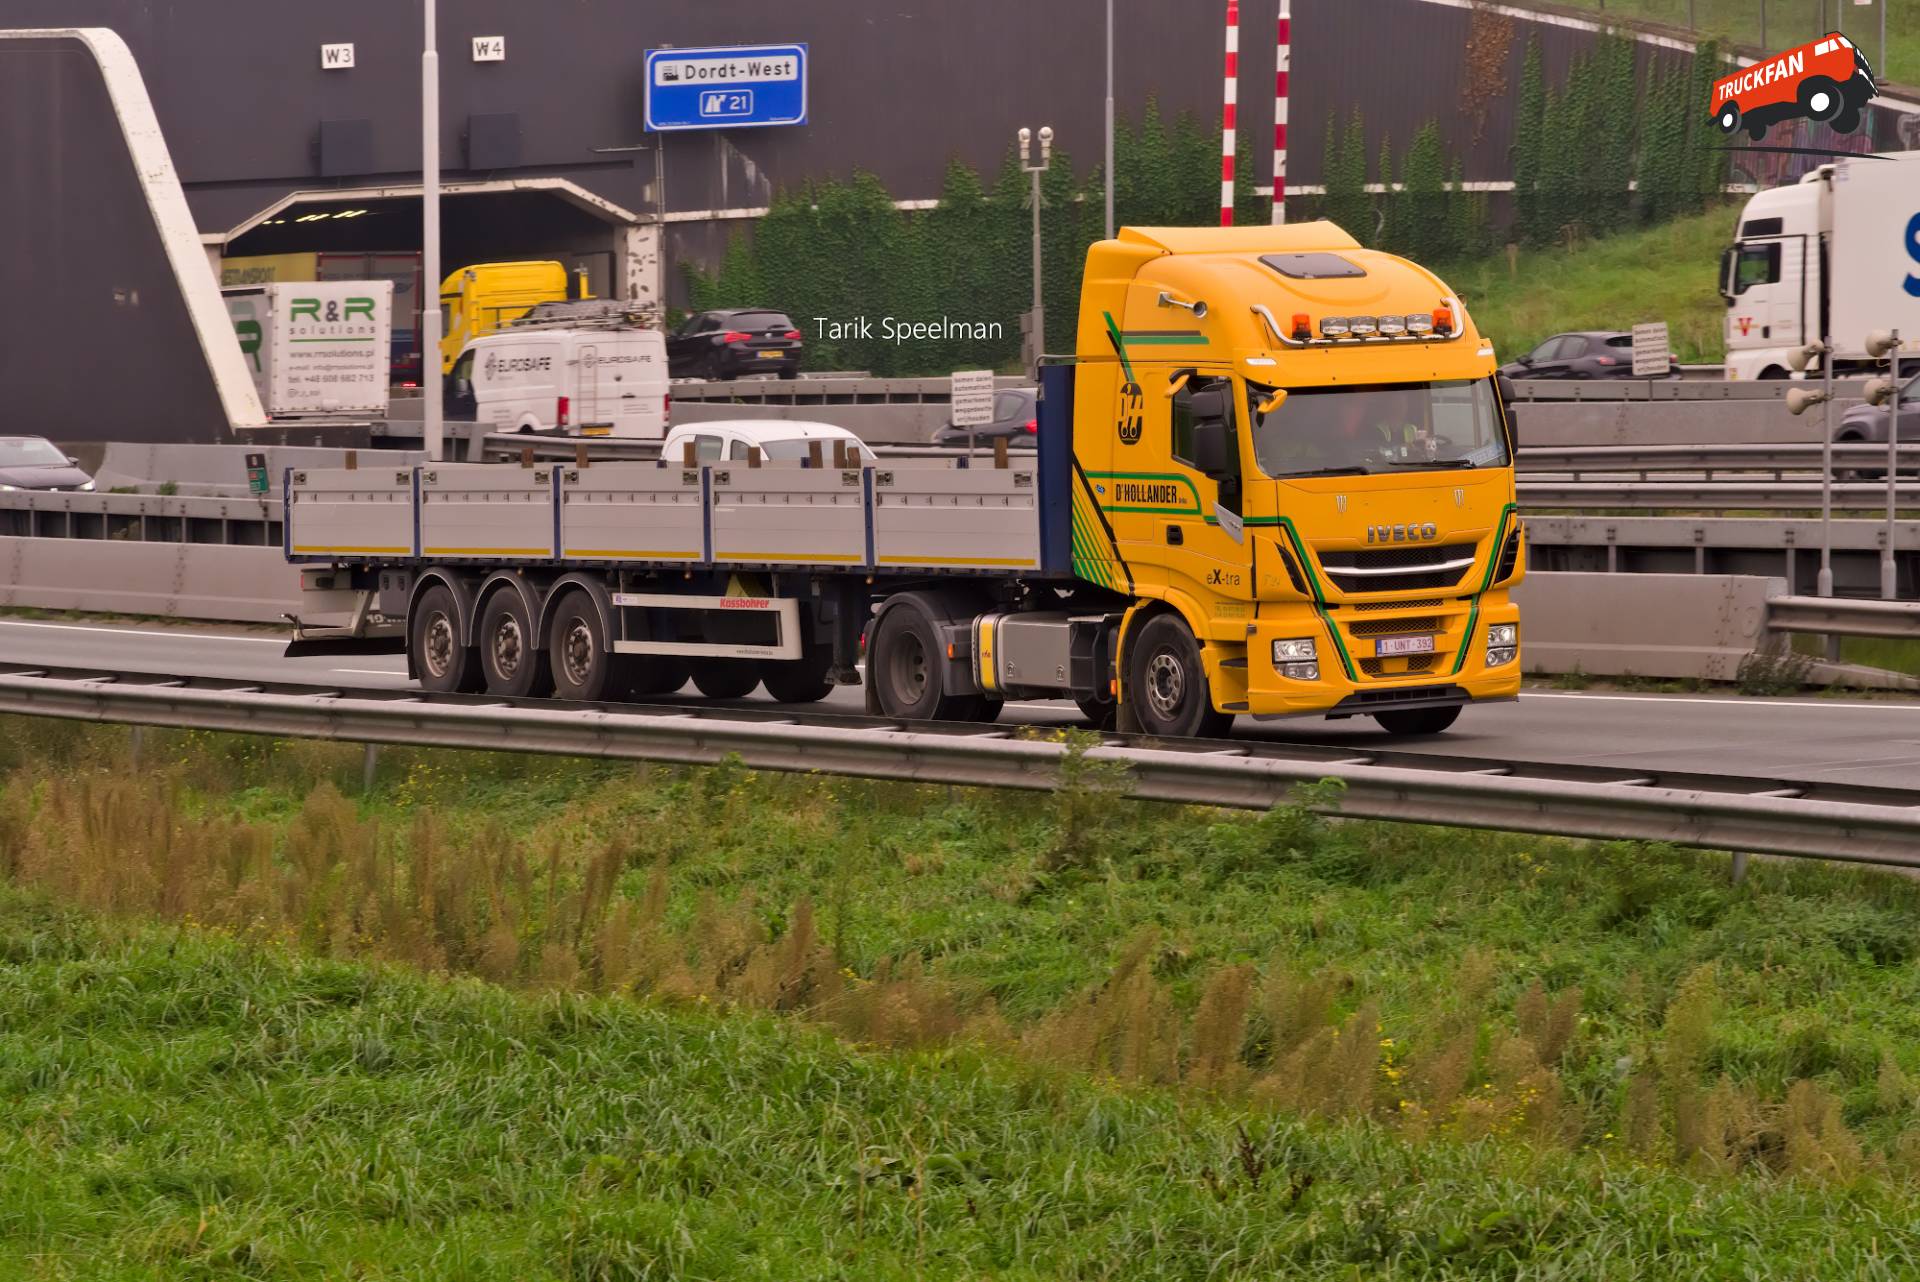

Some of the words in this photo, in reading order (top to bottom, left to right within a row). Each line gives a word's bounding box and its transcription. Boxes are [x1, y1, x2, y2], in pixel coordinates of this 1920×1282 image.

[325, 48, 351, 64] W3
[685, 61, 791, 80] Dordt-West
[729, 95, 747, 110] 21
[290, 297, 376, 322] R&R
[289, 324, 376, 335] solutions
[498, 356, 552, 373] EUROSAFE
[598, 355, 652, 364] EUROSAFE
[1115, 484, 1177, 504] D'HOLLANDER
[1367, 523, 1438, 543] IVECO
[1206, 569, 1240, 586] eX-tra
